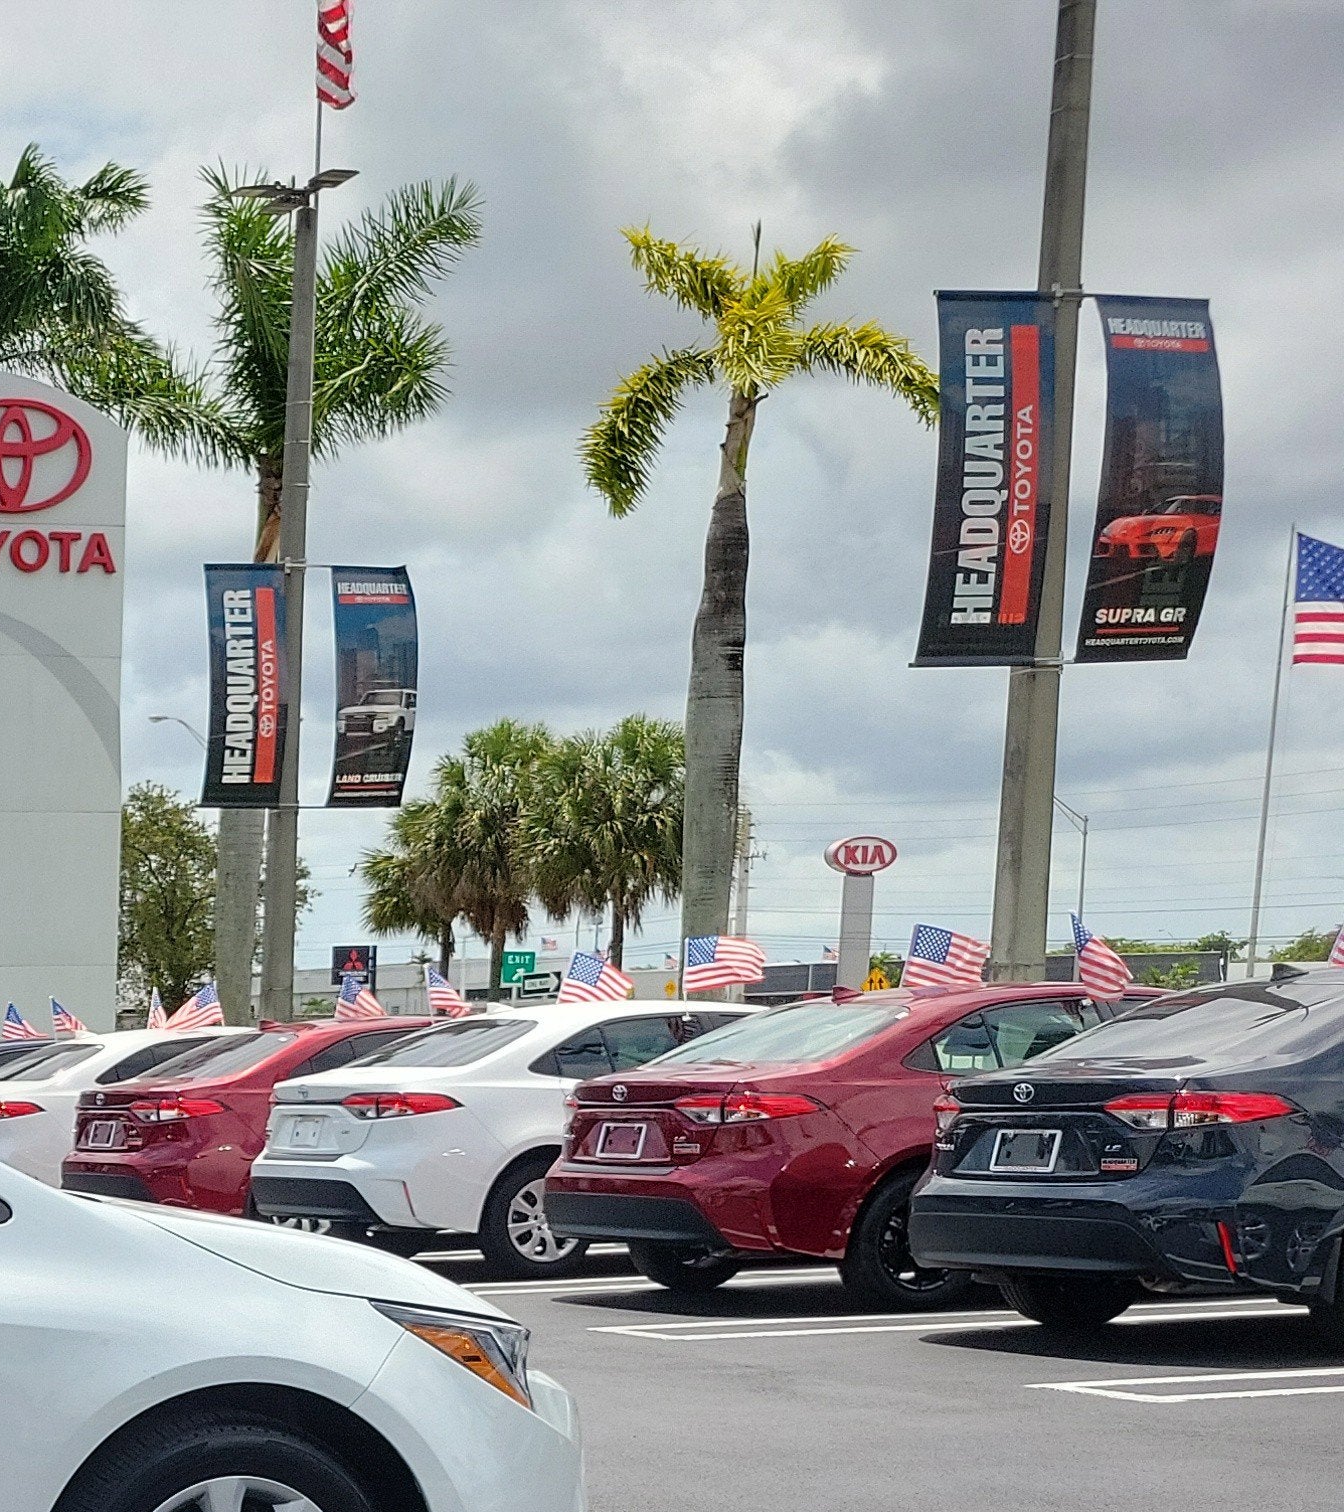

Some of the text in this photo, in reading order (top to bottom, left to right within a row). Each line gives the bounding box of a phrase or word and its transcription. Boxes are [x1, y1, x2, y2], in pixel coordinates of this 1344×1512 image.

[1107, 317, 1207, 339] HEADQUARTER
[1012, 404, 1034, 516] TOYOTA
[950, 327, 1009, 626] HEADQUARTER
[336, 582, 408, 596] HEADQUARTER
[1095, 607, 1187, 625] SUPRA GR
[221, 588, 259, 785] HEADQUARTER
[261, 639, 275, 713] TOYOTA
[335, 772, 404, 784] LAND CRUISER
[844, 844, 886, 865] KIA
[507, 955, 531, 965] EXIT
